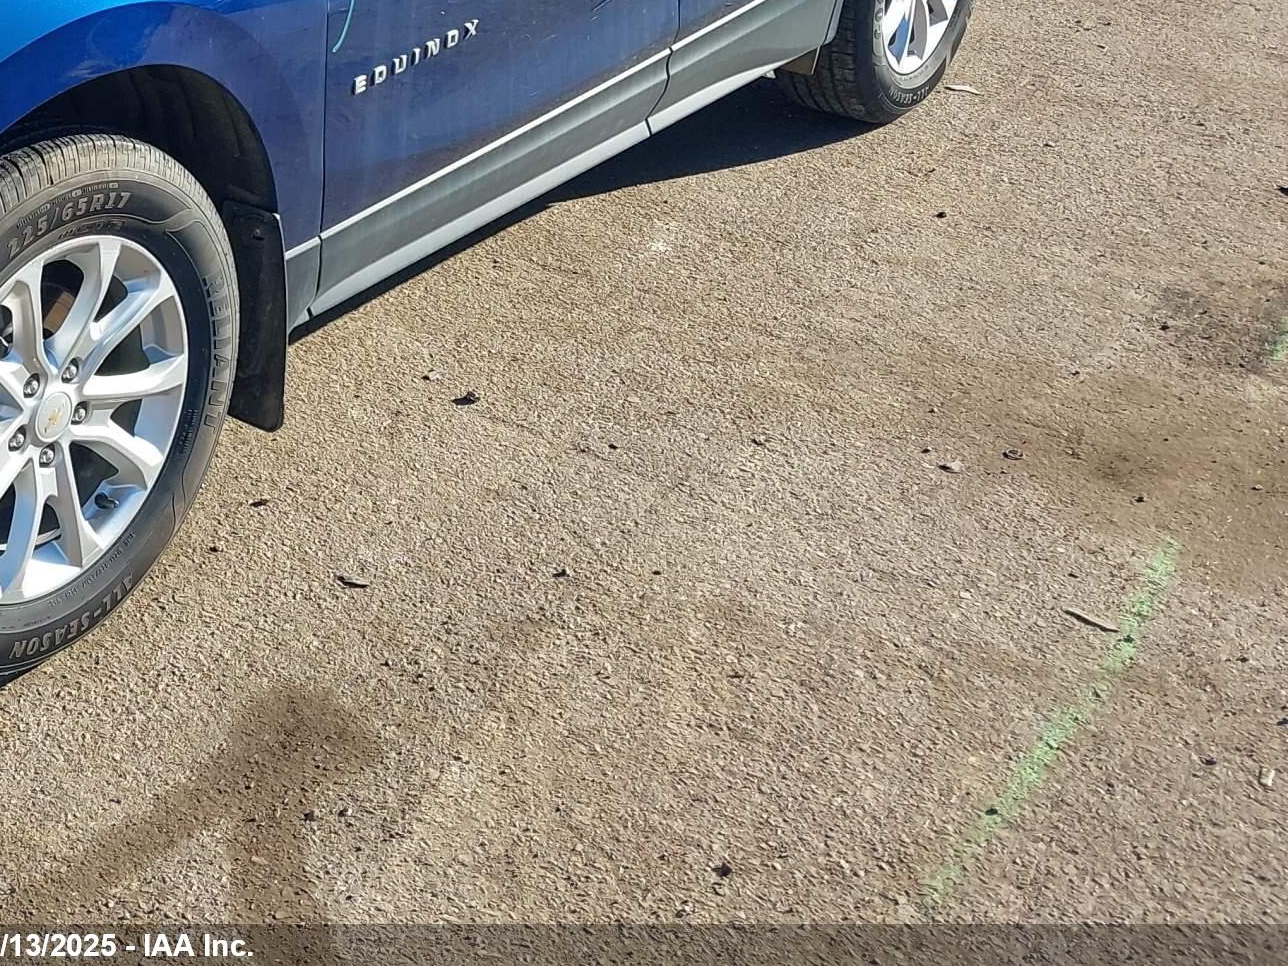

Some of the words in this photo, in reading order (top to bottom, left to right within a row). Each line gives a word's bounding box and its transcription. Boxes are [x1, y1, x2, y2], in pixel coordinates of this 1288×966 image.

[352, 18, 480, 95] EQUINOX
[7, 192, 132, 259] 225/65R17
[8, 572, 134, 659] ALL-SEASON
